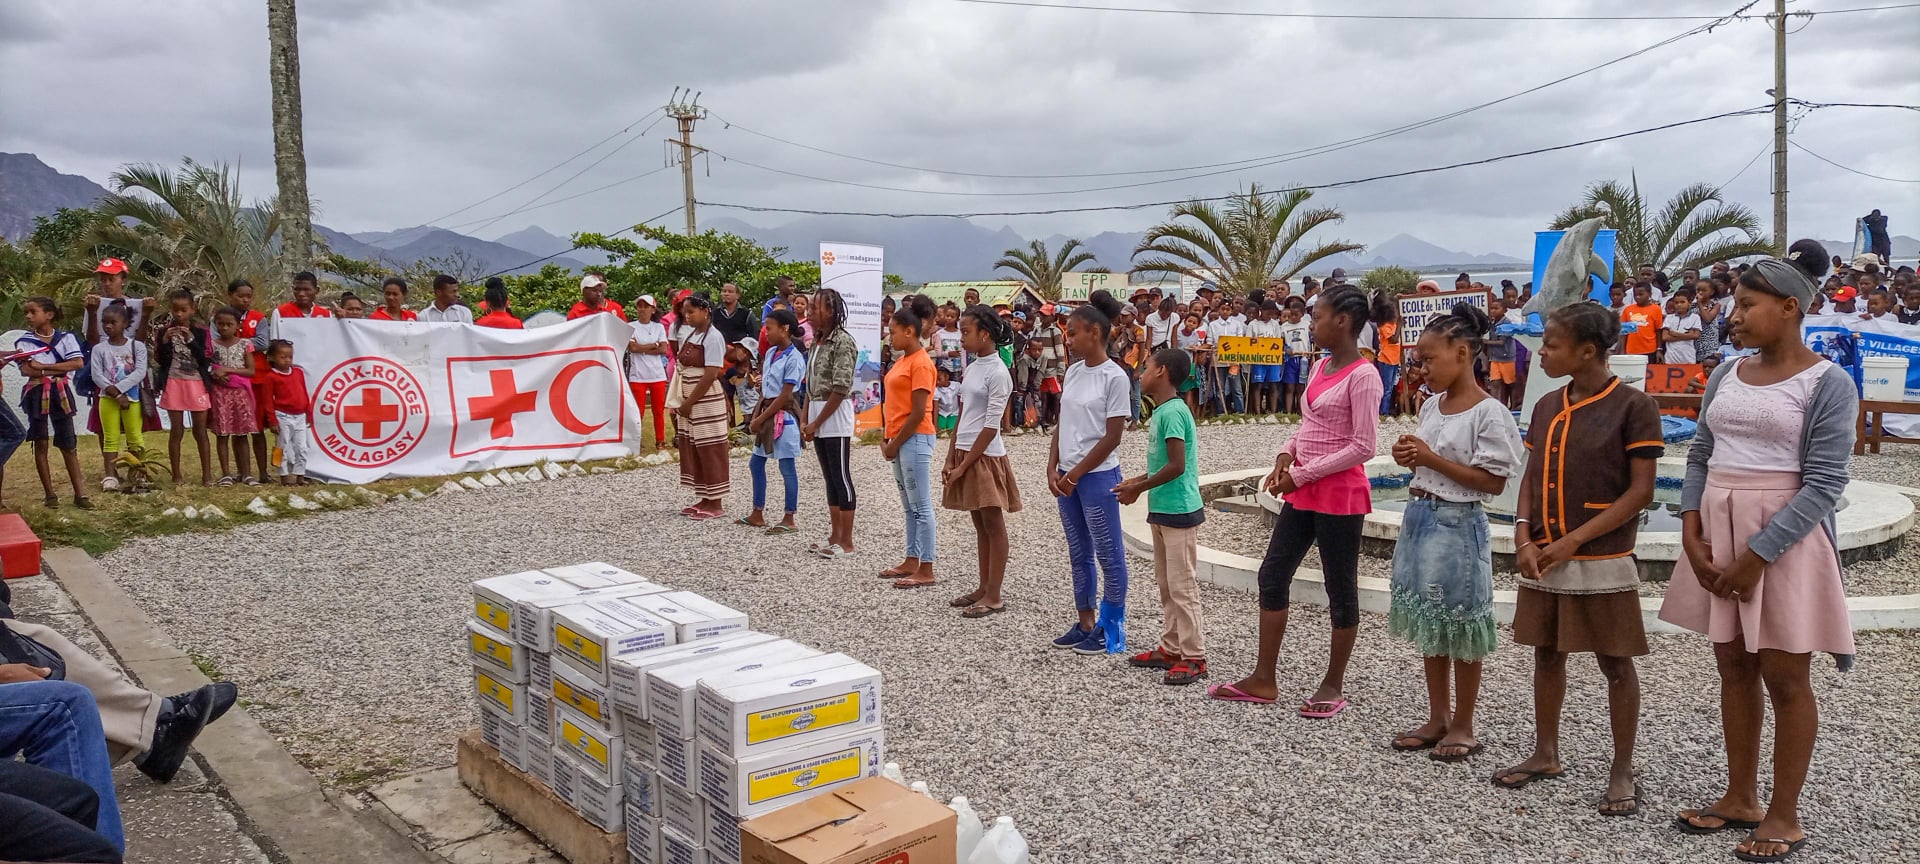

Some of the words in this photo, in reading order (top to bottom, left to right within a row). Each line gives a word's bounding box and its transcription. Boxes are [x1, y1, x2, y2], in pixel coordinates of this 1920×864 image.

[1081, 274, 1108, 285] EPP
[1401, 300, 1425, 314] ECOLE
[1426, 299, 1433, 312] de
[1435, 299, 1441, 311] la
[1402, 314, 1426, 328] FORT
[320, 365, 422, 416] CROIX-ROUGE
[324, 431, 414, 462] MALAGASY
